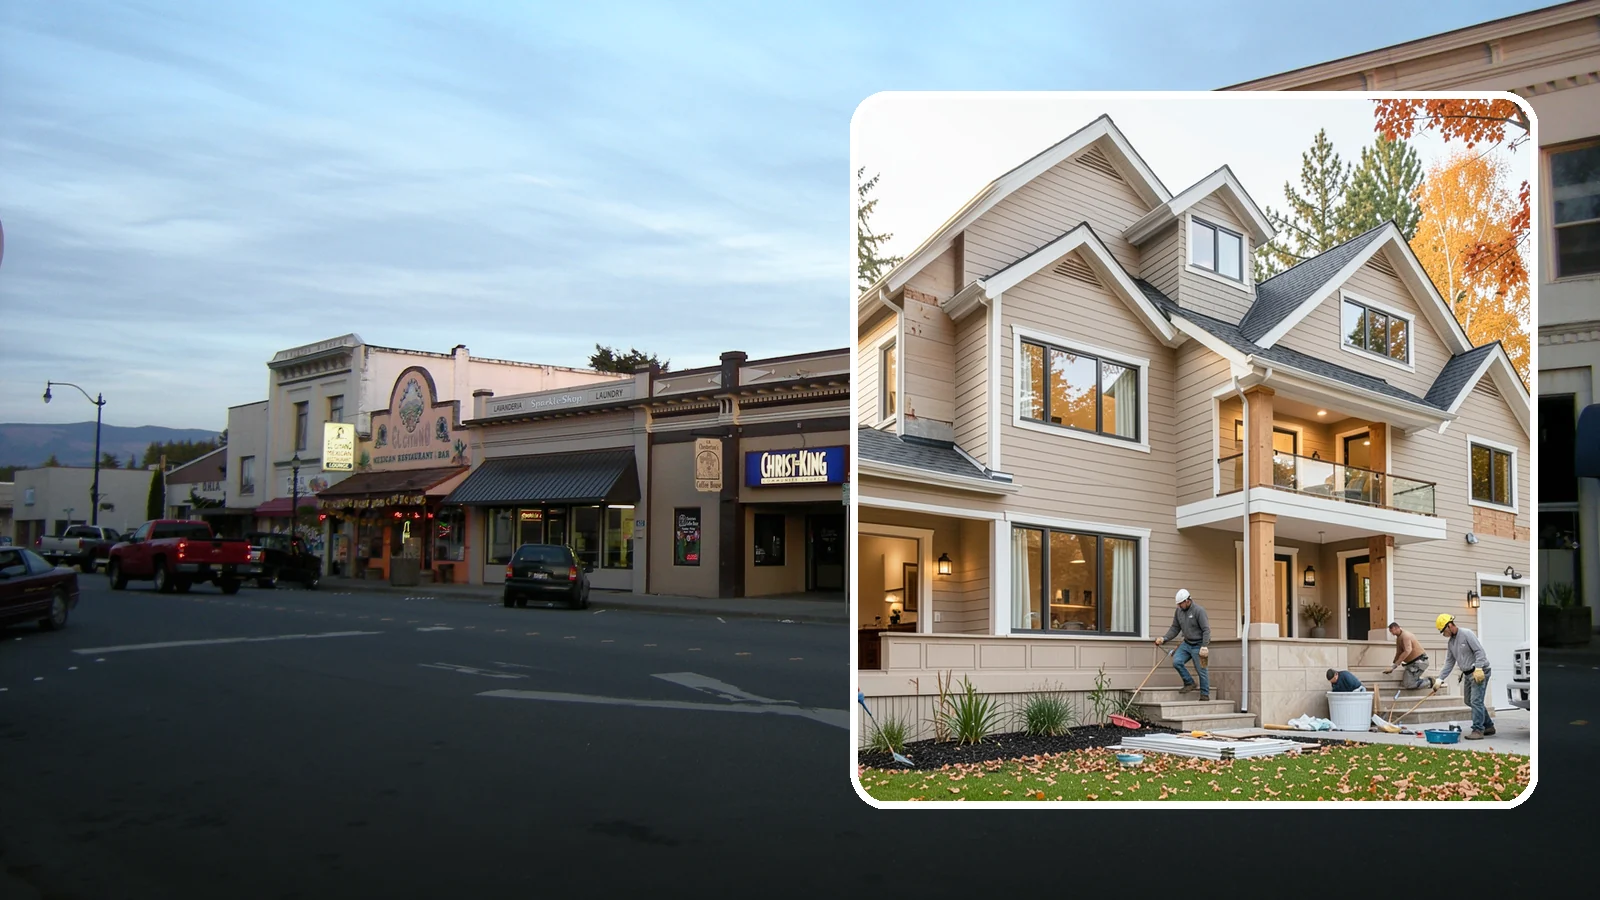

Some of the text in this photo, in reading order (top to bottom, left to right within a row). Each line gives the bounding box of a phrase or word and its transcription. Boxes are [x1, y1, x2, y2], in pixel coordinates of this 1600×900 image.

[493, 402, 522, 413] LAVANDERIA
[561, 394, 582, 405] Shop
[595, 389, 623, 400] LAUNDRY
[373, 450, 450, 464] MEXICAN RESTAURANT BAR
[761, 450, 827, 478] CHRIST KING
